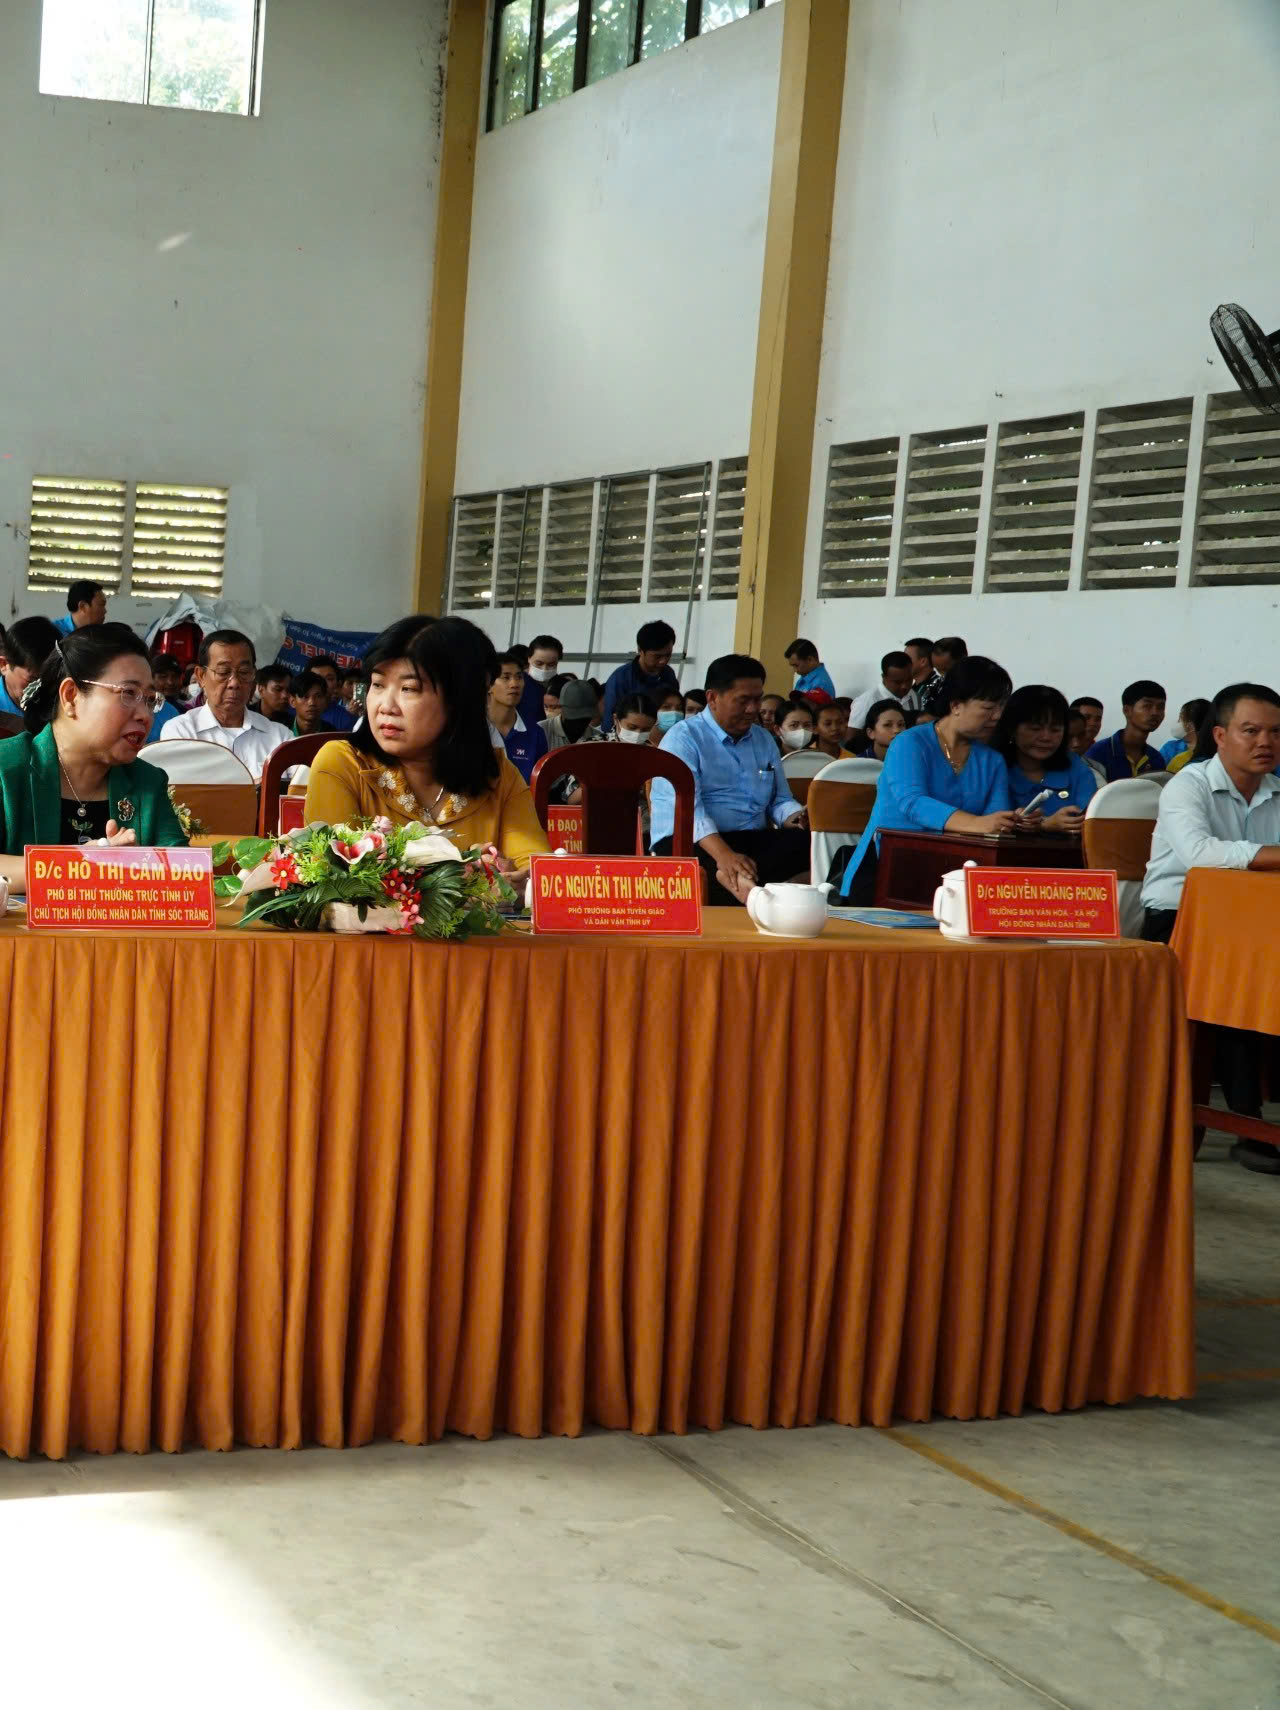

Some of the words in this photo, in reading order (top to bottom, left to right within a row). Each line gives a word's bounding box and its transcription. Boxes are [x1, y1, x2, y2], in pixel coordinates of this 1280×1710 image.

[558, 818, 578, 834] ĐẠO
[35, 860, 62, 880] Đ/c
[68, 854, 91, 880] HỒ
[96, 862, 124, 884] THỊ
[129, 853, 166, 881] CẨM
[170, 858, 205, 881] ĐÀO
[540, 874, 563, 898] Đ/C
[566, 864, 610, 898] NGUYỄN
[612, 876, 632, 904] THỊ
[635, 866, 665, 900] HỒNG
[668, 865, 692, 900] CẨM
[977, 884, 994, 899] Đ/c
[996, 878, 1038, 900] NGUYỄN
[1076, 886, 1108, 901] PHONG
[46, 886, 64, 900] PHÓ
[68, 886, 76, 900] BÍ
[80, 888, 97, 900] THƯ
[99, 886, 134, 902] THƯỜNG
[136, 888, 158, 904] TRỰC
[160, 886, 180, 902] TỈNH
[184, 886, 194, 902] ỦY
[34, 904, 50, 920] CHỦ
[52, 907, 70, 922] TỊCH
[72, 904, 84, 922] HỘI
[110, 906, 130, 920] NHÂN
[132, 906, 146, 920] DÂN
[149, 905, 166, 920] TỈNH
[168, 906, 182, 920] SÓC
[184, 907, 208, 920] TRĂNG
